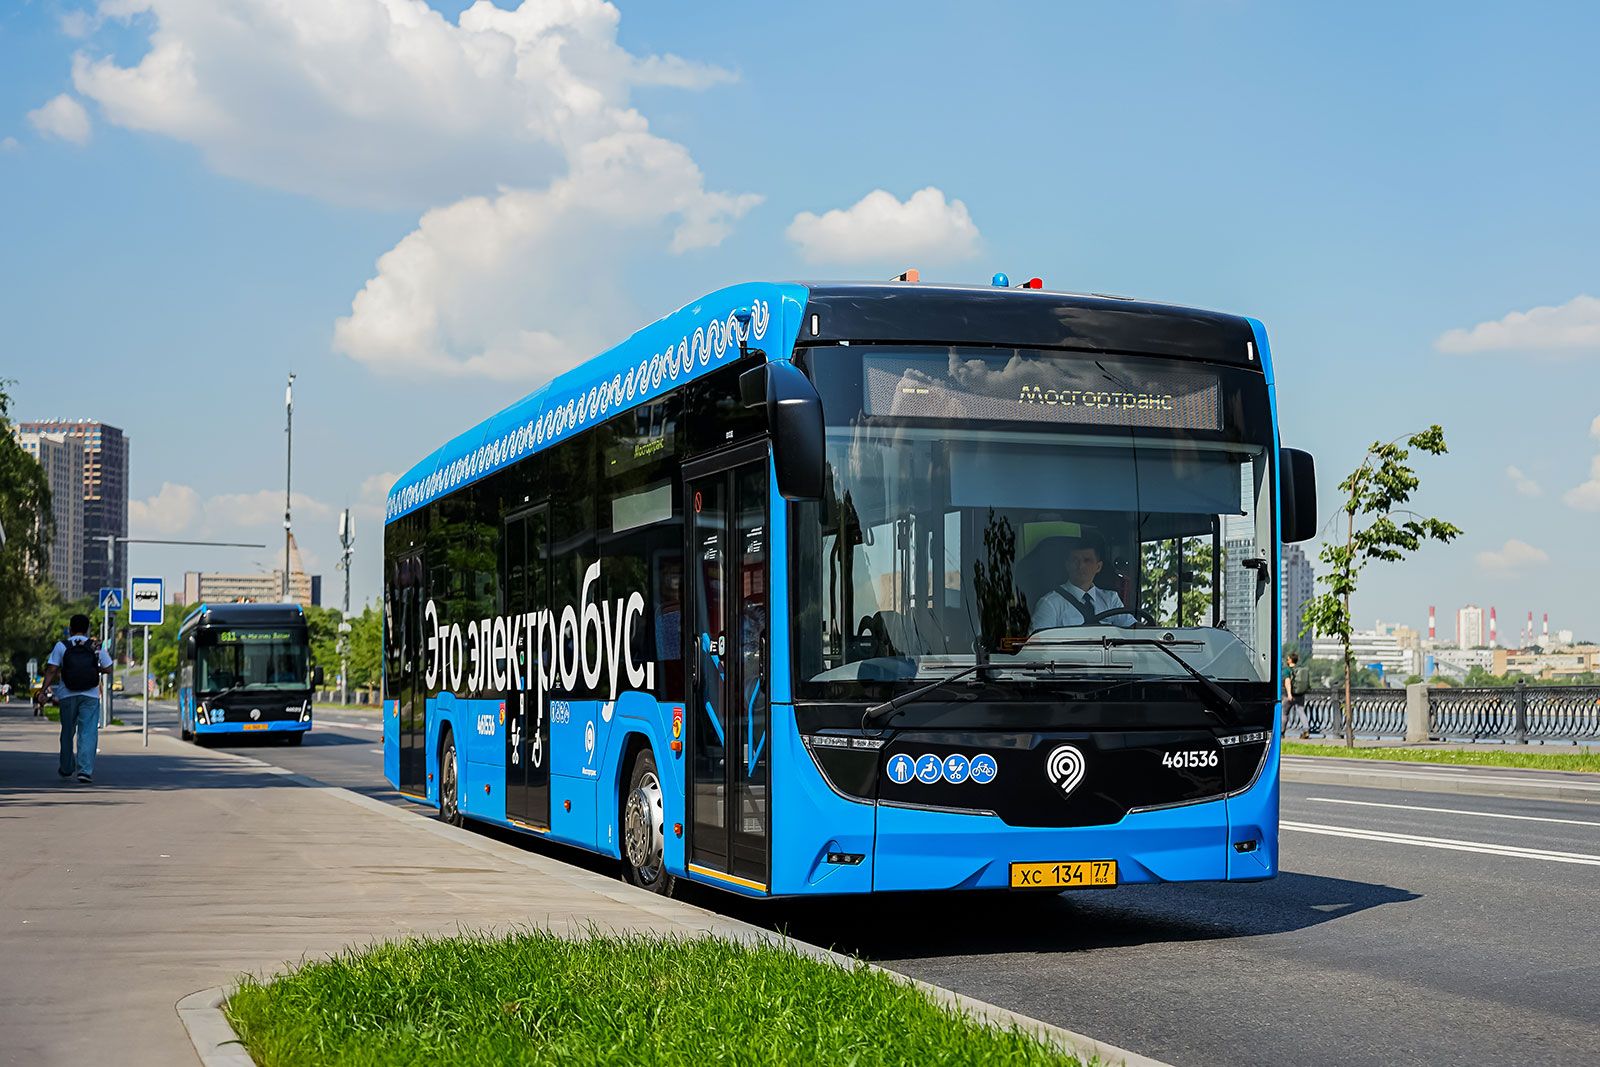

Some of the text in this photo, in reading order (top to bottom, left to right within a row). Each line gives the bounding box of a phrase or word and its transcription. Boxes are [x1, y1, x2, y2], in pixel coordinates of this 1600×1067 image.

[1018, 383, 1173, 410] Мосгортранс
[425, 559, 655, 723] Это электробус.
[1162, 750, 1218, 768] 461536
[1052, 865, 1082, 883] 134
[1093, 863, 1110, 877] 77
